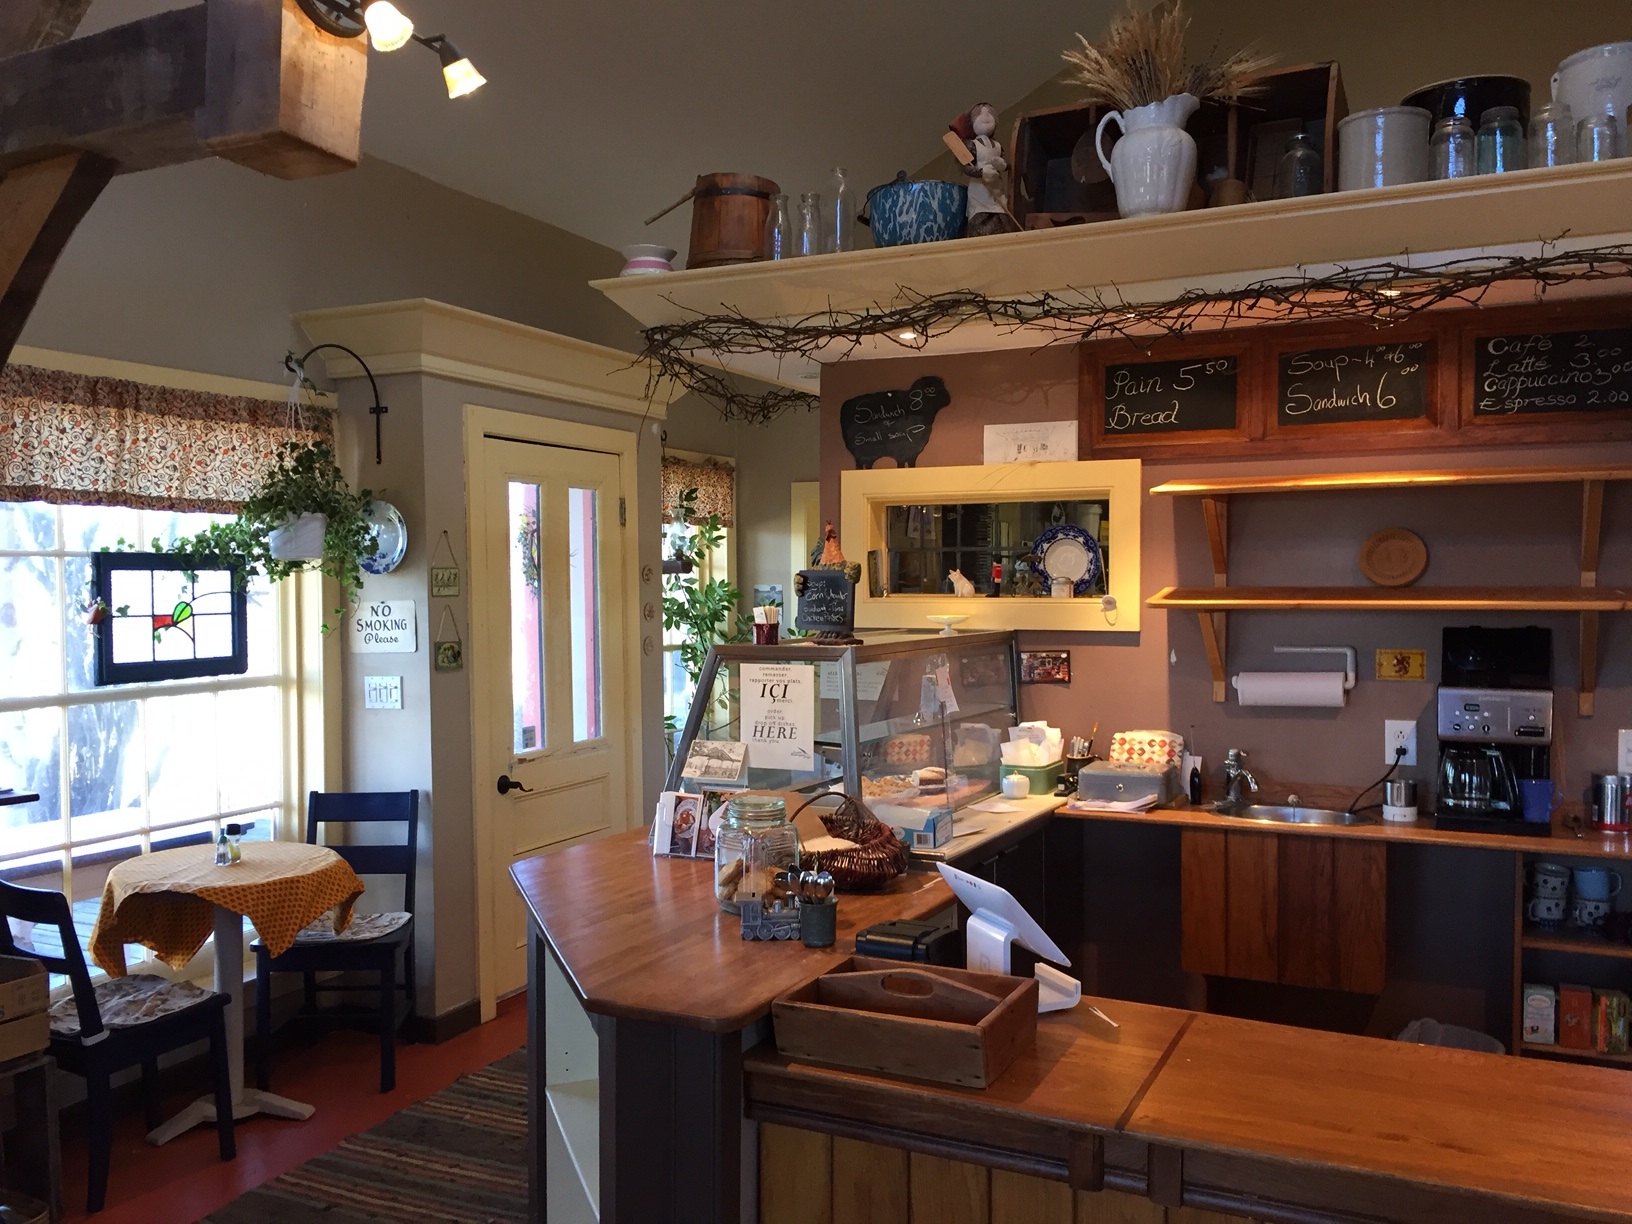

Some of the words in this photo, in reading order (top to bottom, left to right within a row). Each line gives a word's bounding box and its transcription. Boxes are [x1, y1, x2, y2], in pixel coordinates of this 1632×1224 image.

[1287, 353, 1349, 382] Soup
[1105, 368, 1164, 400] Pain
[1484, 368, 1593, 399] Cappuccino
[1285, 382, 1371, 415] Sandwich
[1479, 393, 1577, 415] Espresso
[853, 401, 906, 424] Sandwich
[1105, 400, 1180, 430] Bread
[853, 430, 883, 446] Small
[887, 424, 926, 443] soup
[805, 588, 824, 601] Corn
[370, 604, 392, 618] NO
[356, 618, 408, 632] SMOKING
[363, 632, 400, 645] Please
[760, 683, 789, 704] IÇI
[752, 725, 798, 740] HERE
